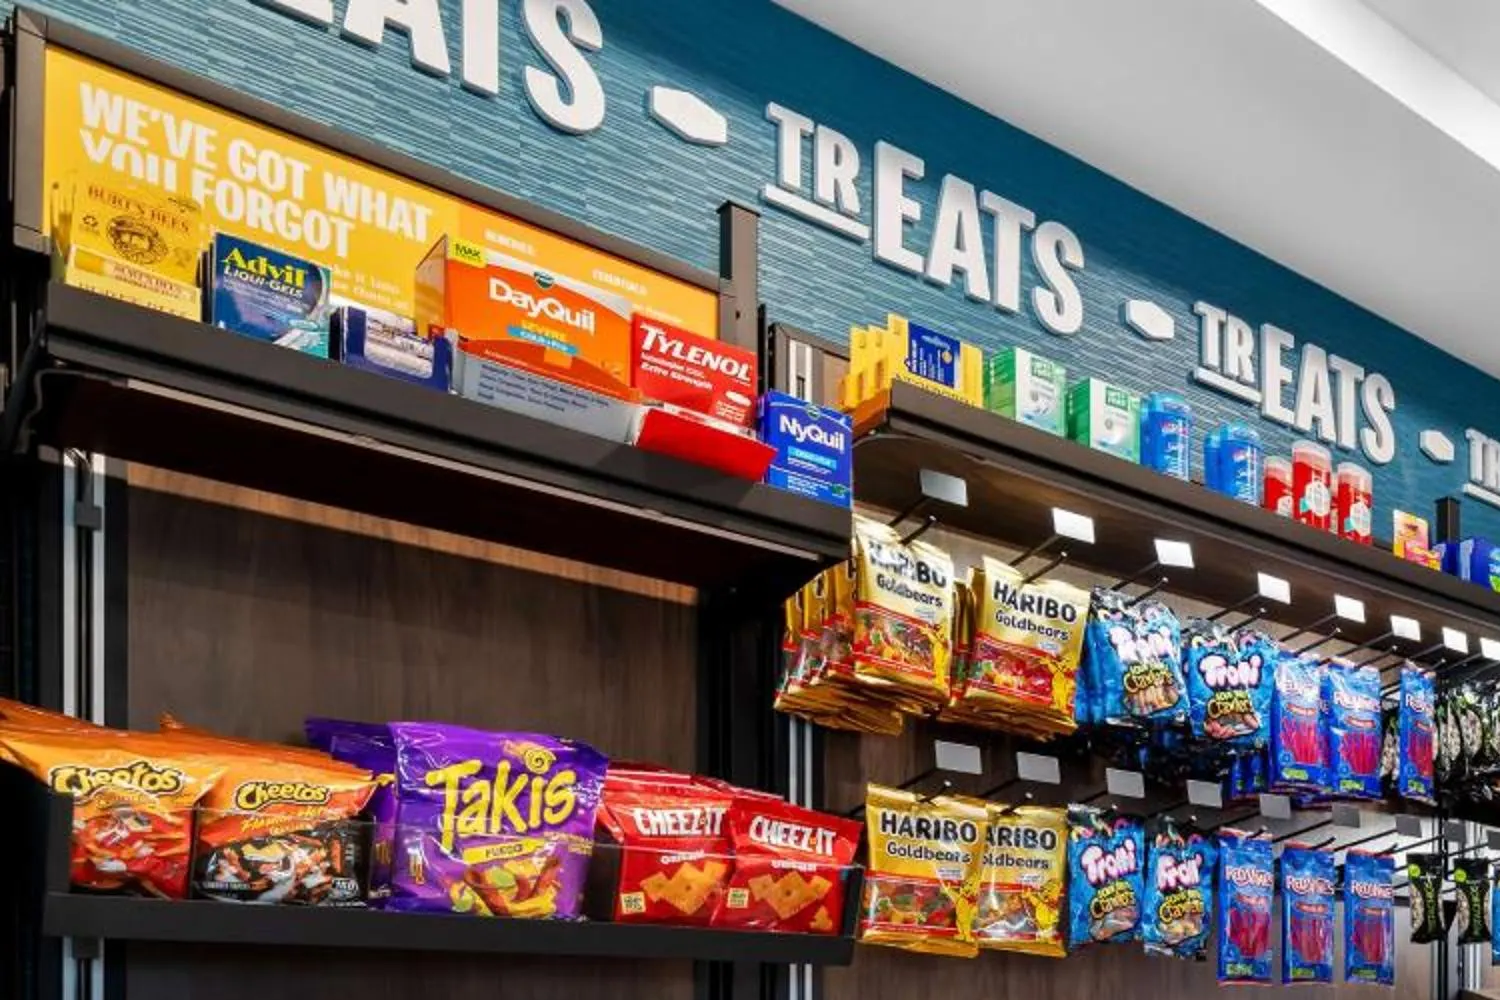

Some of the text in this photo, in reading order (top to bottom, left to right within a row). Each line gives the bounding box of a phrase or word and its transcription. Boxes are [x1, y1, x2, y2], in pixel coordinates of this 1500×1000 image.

[80, 81, 433, 244] WE'VE GOT WHAT
[191, 167, 356, 258] FORGOT
[762, 102, 1085, 336] TREATS
[222, 247, 307, 288] Advil
[455, 243, 481, 258] MAX
[489, 277, 596, 336] DayQuil
[640, 322, 752, 382] TYLENOL
[1194, 300, 1396, 466] TREATS
[779, 415, 846, 454] NyQuil
[994, 580, 1078, 623] HARIBO
[994, 610, 1070, 642] Goldbears
[51, 762, 184, 794] Cheetos
[237, 781, 329, 810] Cheetos
[426, 752, 577, 853] Takis
[633, 806, 727, 836] CHEEZ-IT
[750, 815, 837, 856] CHEEZ-IT
[881, 811, 979, 844] HARIBO
[985, 825, 1058, 851] ARIBO
[887, 842, 971, 864] Goldbears
[982, 851, 1050, 869] oldbears
